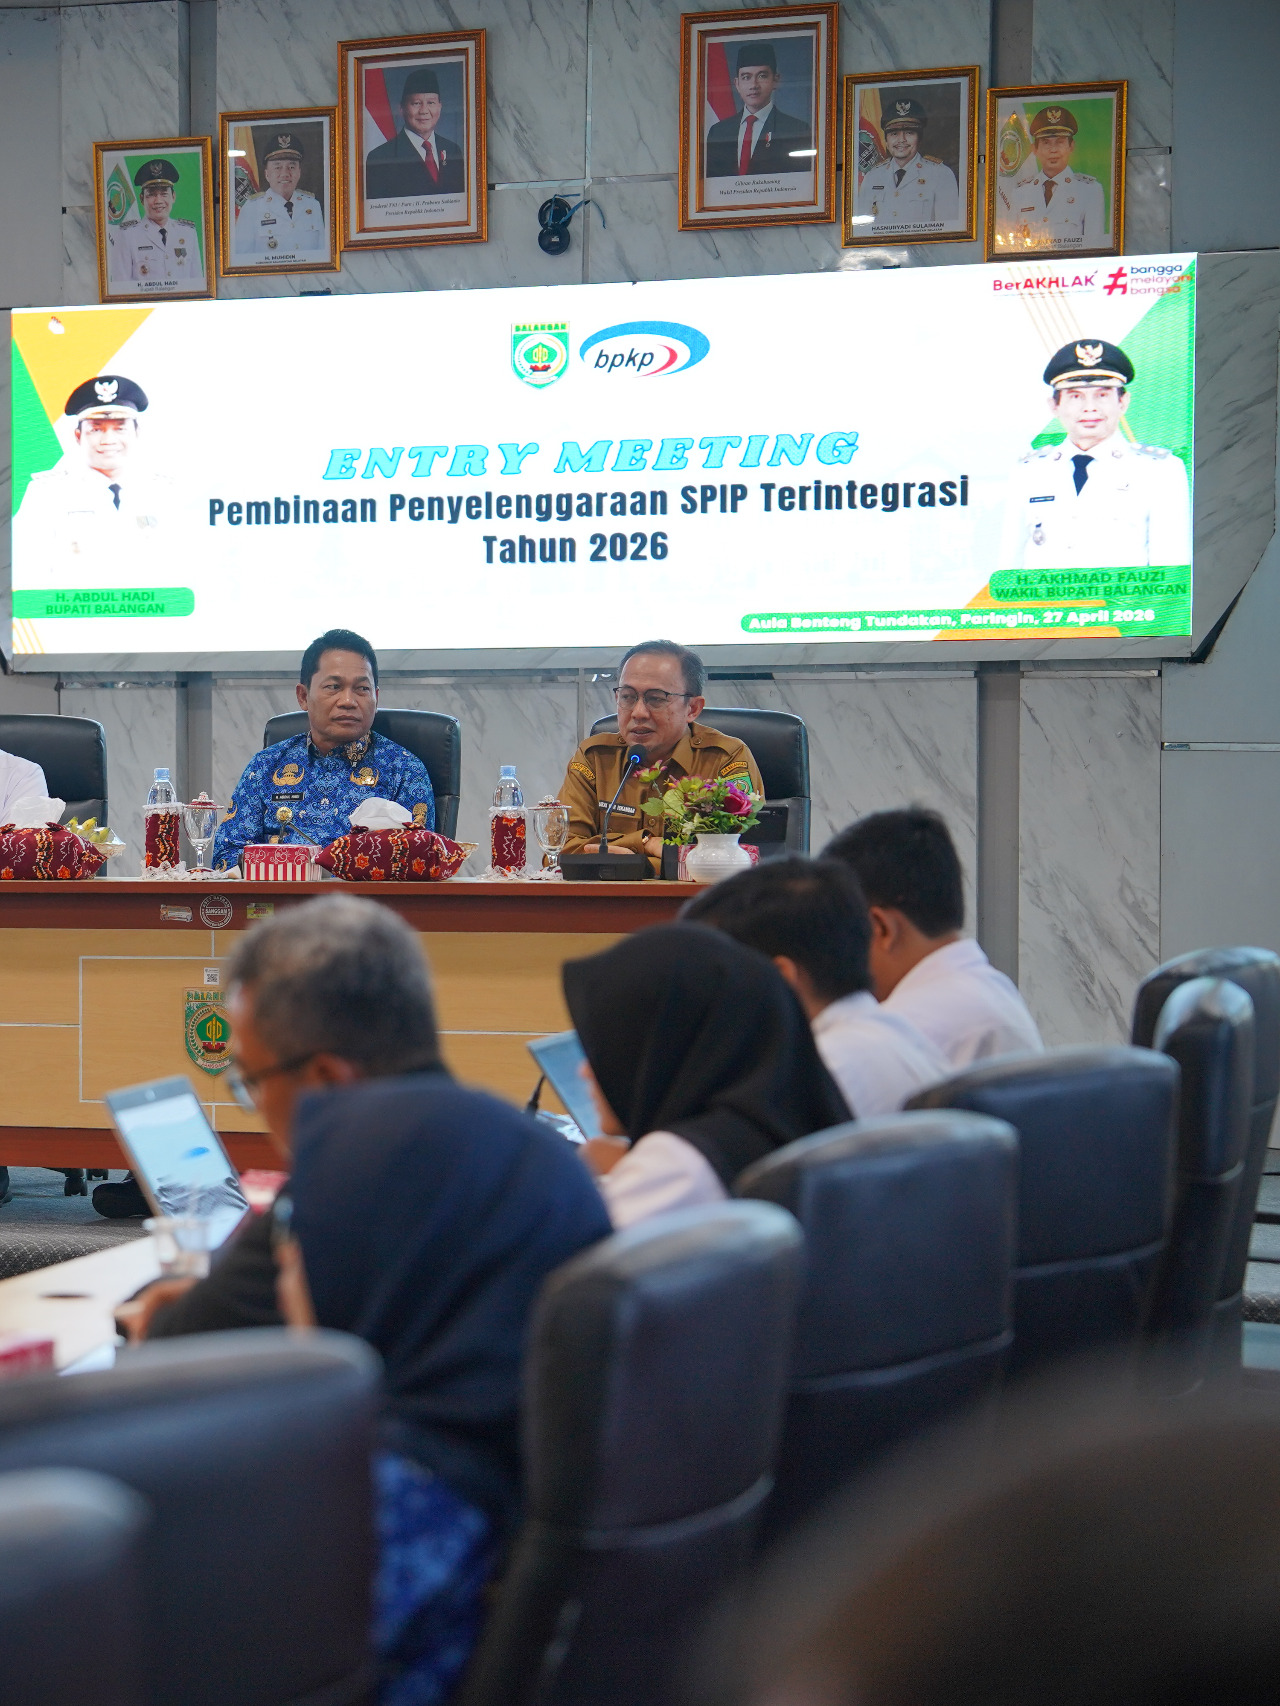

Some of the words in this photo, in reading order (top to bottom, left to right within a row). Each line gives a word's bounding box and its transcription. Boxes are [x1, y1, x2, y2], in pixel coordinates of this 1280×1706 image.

[1130, 264, 1183, 276] bangga
[993, 274, 1095, 291] BerAKHLAK
[1130, 274, 1194, 285] melayani
[1130, 285, 1181, 296] bangsa
[515, 323, 567, 332] BALANGAN
[594, 348, 655, 373] bpkp
[322, 442, 539, 480] ENTRY
[554, 432, 858, 473] MEETING
[209, 495, 377, 526] Pembinaan
[390, 490, 668, 524] Penyelenggaraan
[681, 484, 748, 514] SPIP
[760, 475, 969, 512] Terintegrasi
[482, 534, 576, 564] Tahun
[589, 531, 669, 562] 2026
[1017, 575, 1034, 585] H.
[1038, 573, 1111, 584] AKHMAD
[1119, 571, 1165, 582] FAUZI
[56, 593, 69, 602] H.
[74, 592, 118, 602] ABDUL
[122, 592, 155, 601] HADI
[995, 587, 1043, 598] WAKIL
[1047, 586, 1098, 597] BUPATI
[1104, 584, 1186, 596] BALANGAN
[46, 604, 91, 614] BUPATI
[95, 603, 165, 614] BALANGAN
[749, 617, 788, 629] Aula
[791, 617, 861, 631] Benteng
[865, 614, 956, 628] Tundakan,
[960, 612, 1040, 628] Paringin,
[1043, 611, 1063, 623] 27
[1067, 610, 1109, 626] April
[1112, 609, 1155, 622] 2026
